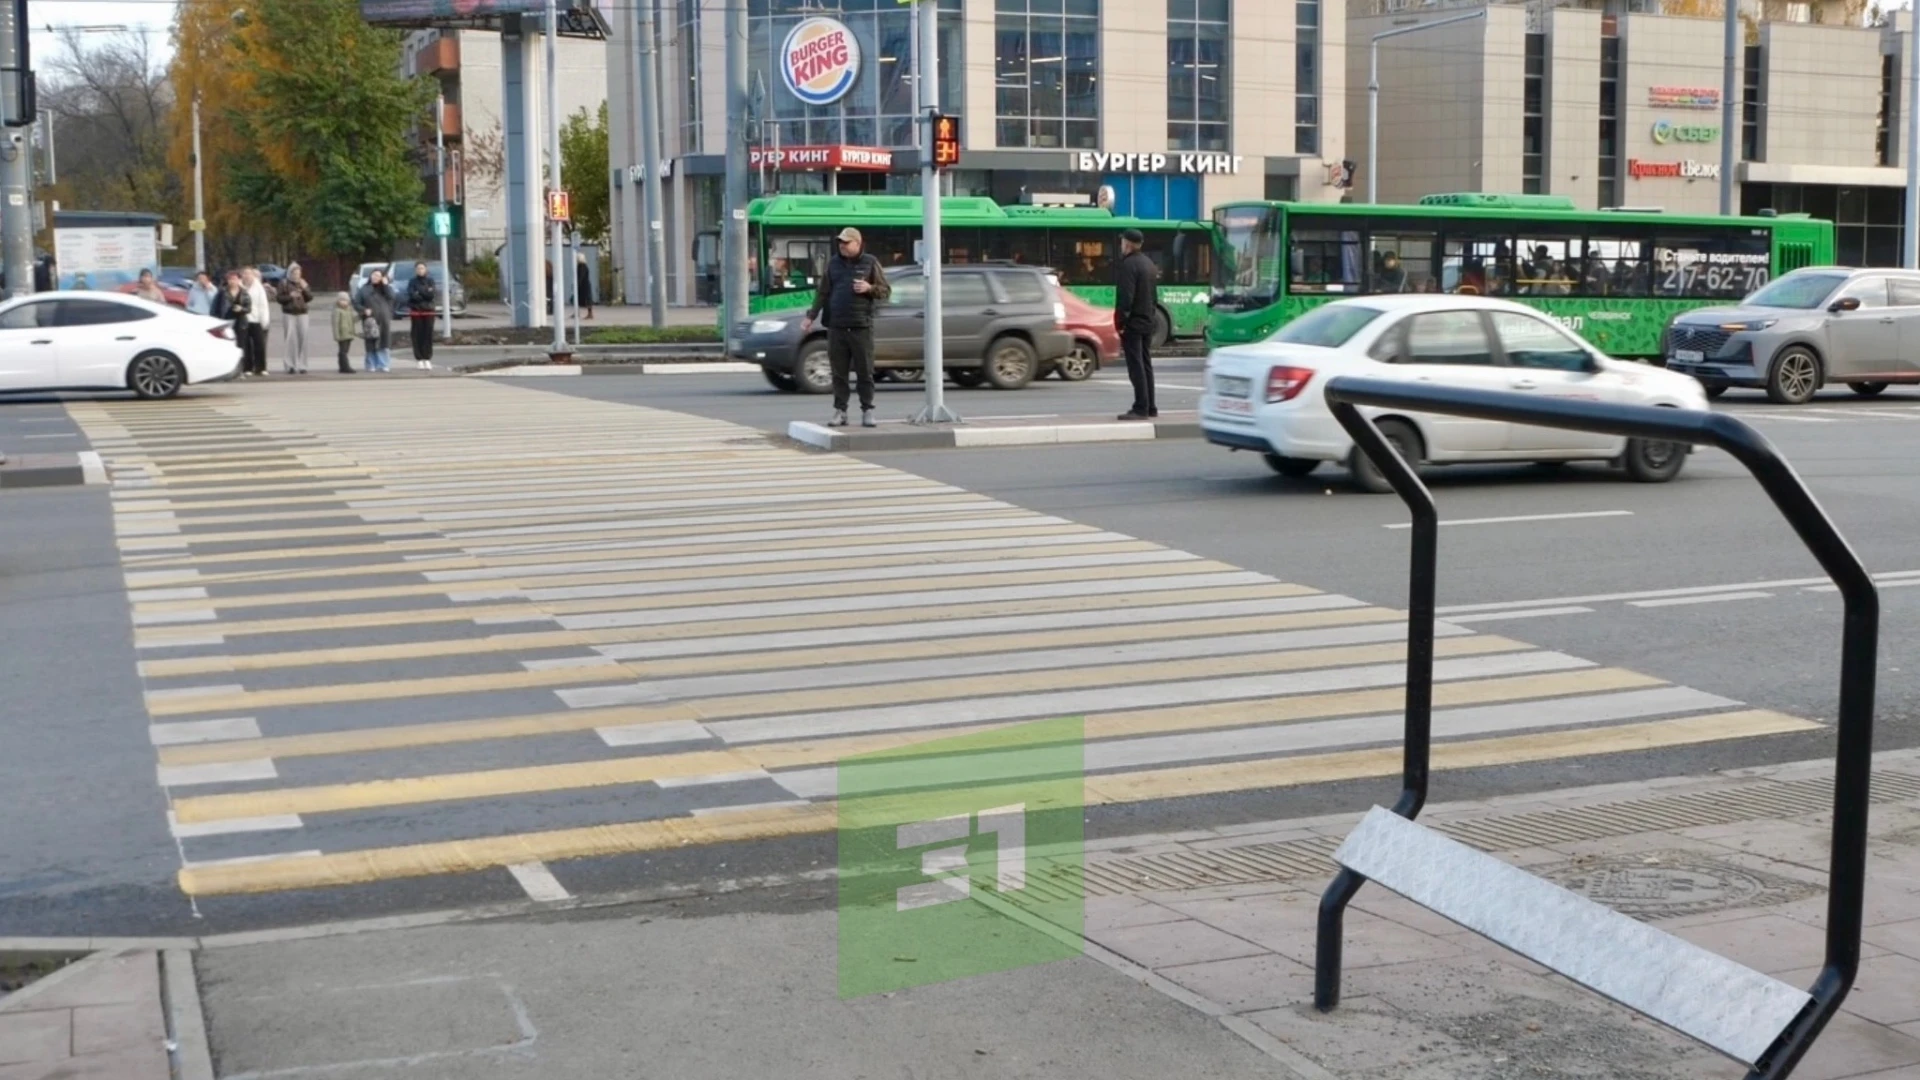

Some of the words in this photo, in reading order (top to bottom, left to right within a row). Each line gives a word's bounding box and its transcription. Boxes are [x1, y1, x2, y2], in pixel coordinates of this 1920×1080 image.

[790, 31, 844, 66] BURGER
[794, 45, 848, 87] KING
[750, 151, 786, 164] РГЕР
[788, 150, 830, 163] КИНГ
[841, 149, 870, 165] БУРГЕР
[871, 152, 893, 166] КИНГ
[936, 140, 956, 161] 34
[1079, 151, 1166, 172] БУРГЕР
[1180, 153, 1243, 174] КИНГ
[1709, 252, 1770, 265] водителем!
[1663, 266, 1769, 290] 217-62-70
